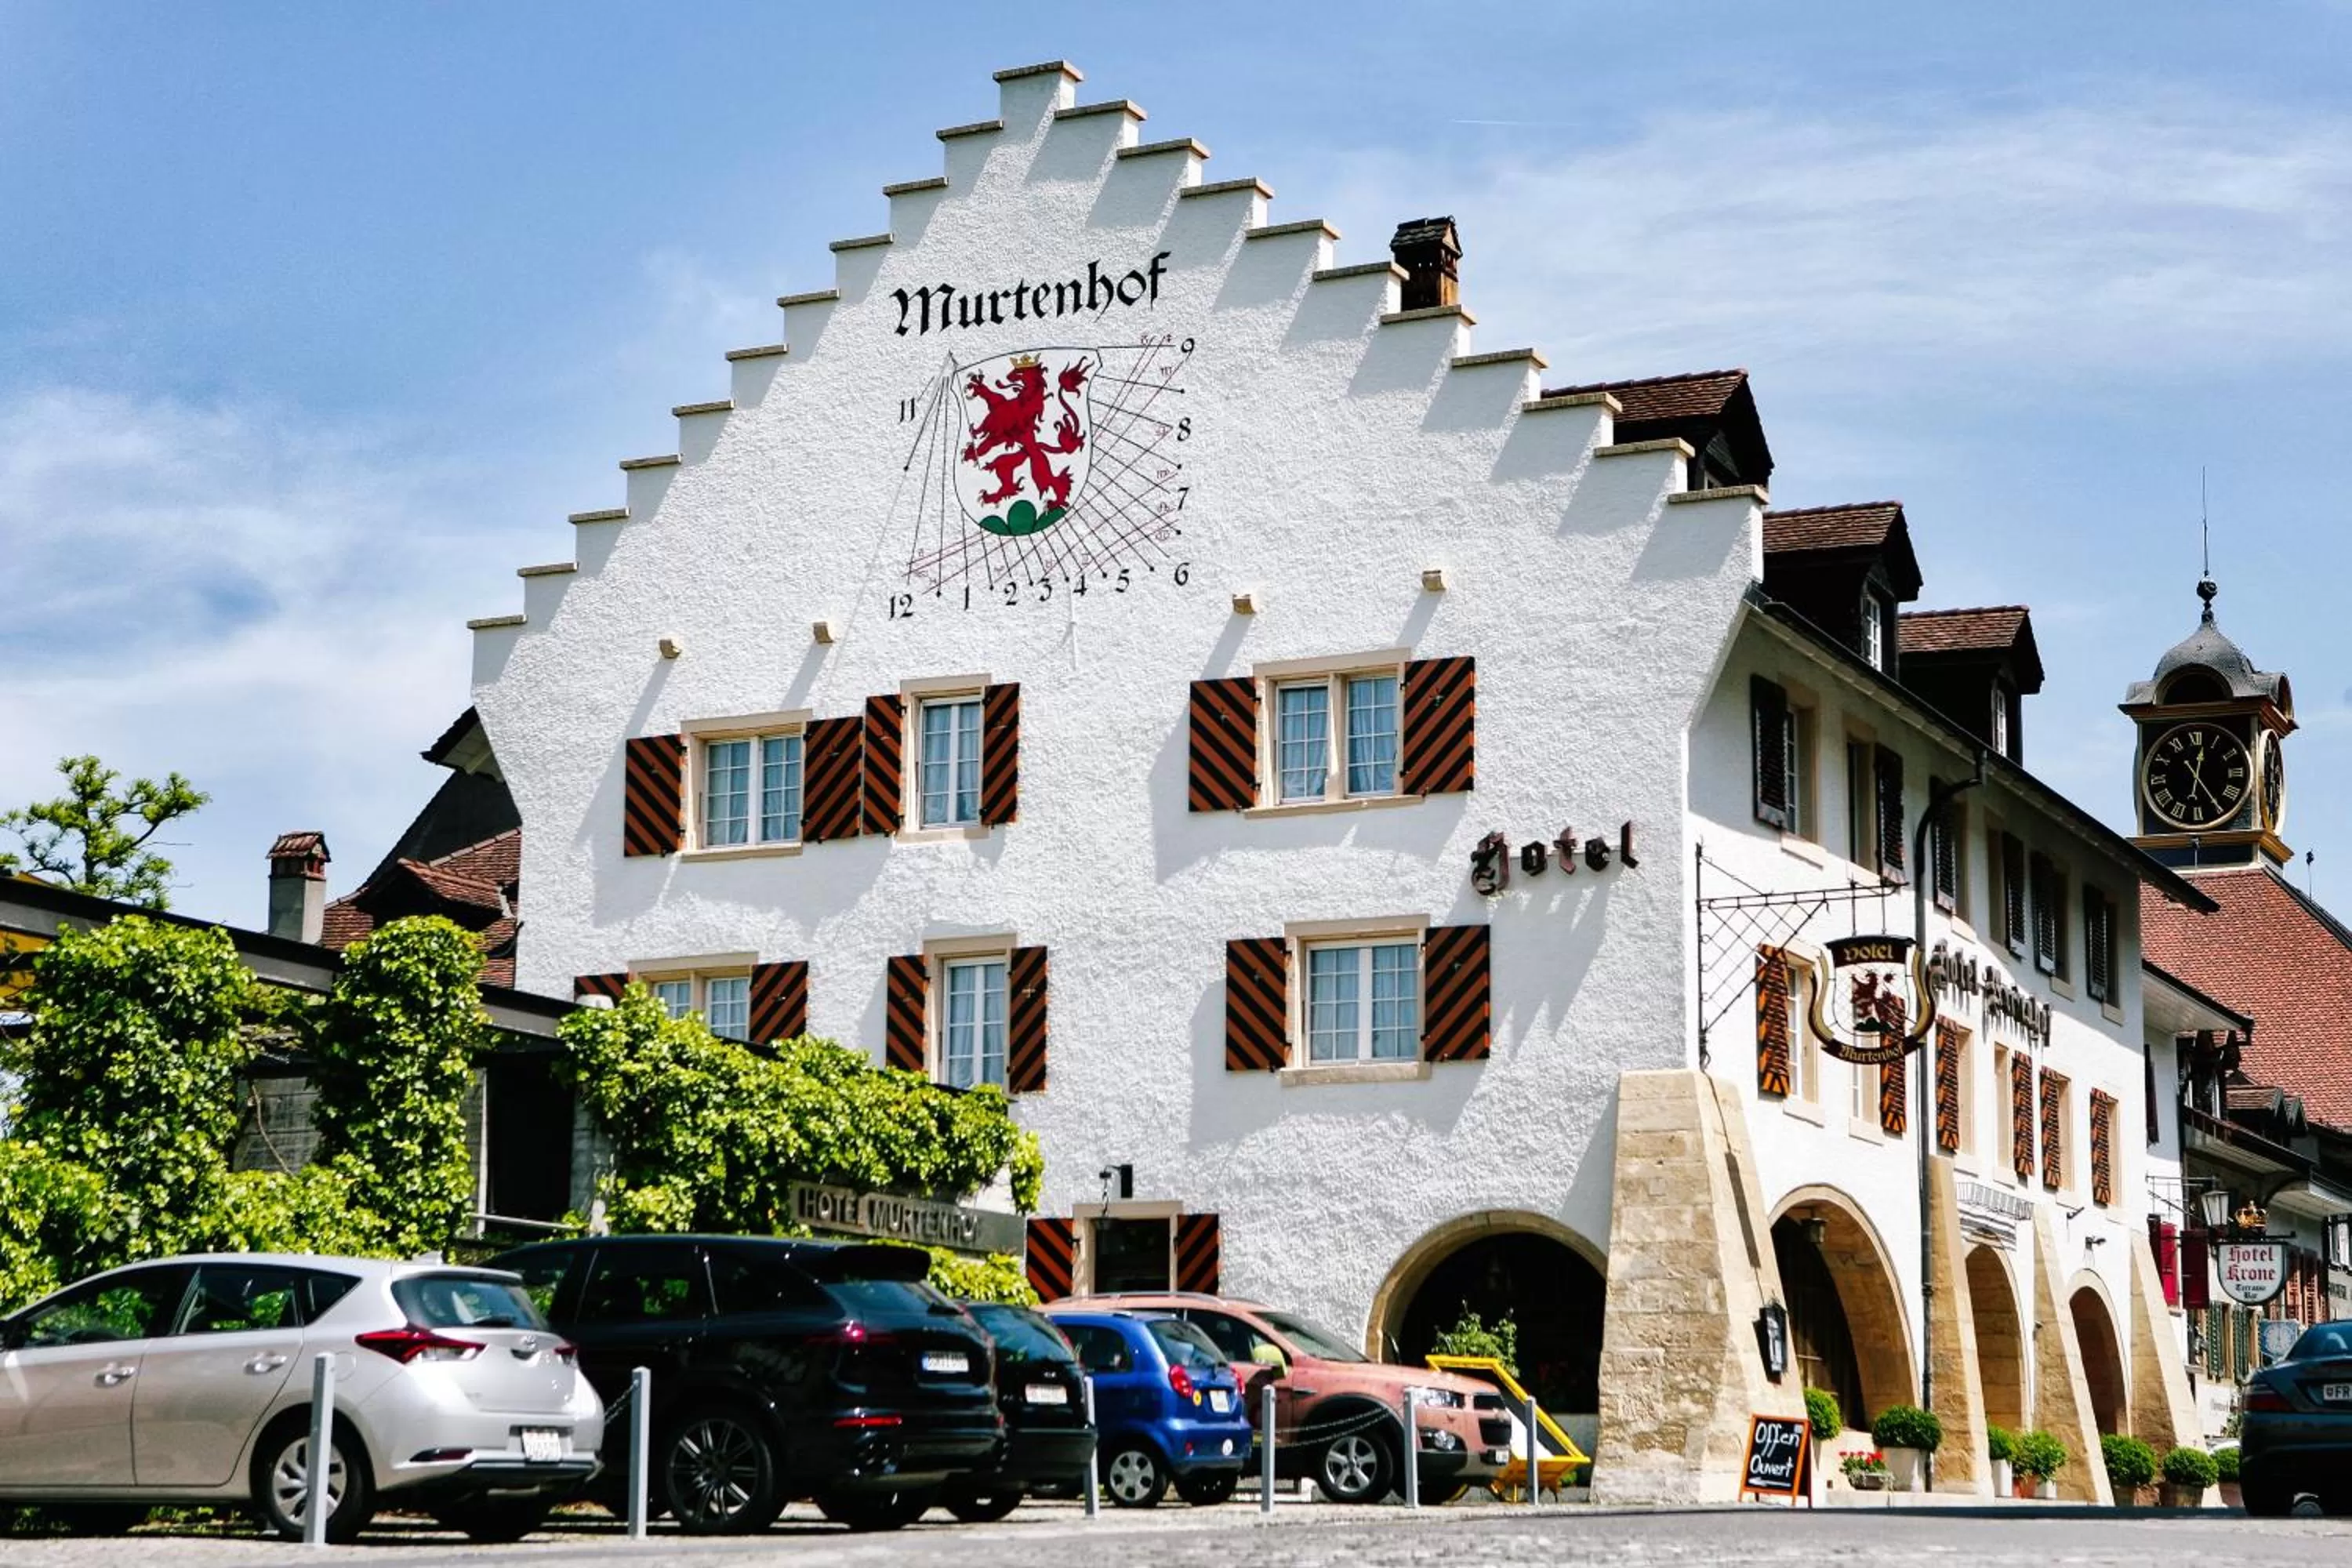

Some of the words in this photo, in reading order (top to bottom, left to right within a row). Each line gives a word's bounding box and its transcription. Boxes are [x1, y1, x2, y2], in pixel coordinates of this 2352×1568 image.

[890, 251, 1171, 336] Murtenhof
[1181, 338, 1195, 361] 9
[1177, 417, 1191, 441] 8
[1178, 487, 1189, 510] 7
[1073, 574, 1087, 596] 4
[1115, 568, 1130, 593] 5
[1174, 562, 1189, 586] 6
[1004, 582, 1018, 605] 2
[1039, 578, 1052, 601] 3
[889, 593, 913, 619] 12
[1471, 819, 1640, 896] Hotel
[1843, 943, 1894, 961] Hotel
[1838, 1044, 1905, 1062] Murtenhof
[2227, 1246, 2274, 1263] Hotel
[2227, 1264, 2275, 1281] Krone
[1755, 1421, 1799, 1457] Offen
[1750, 1454, 1794, 1477] Ouvert
